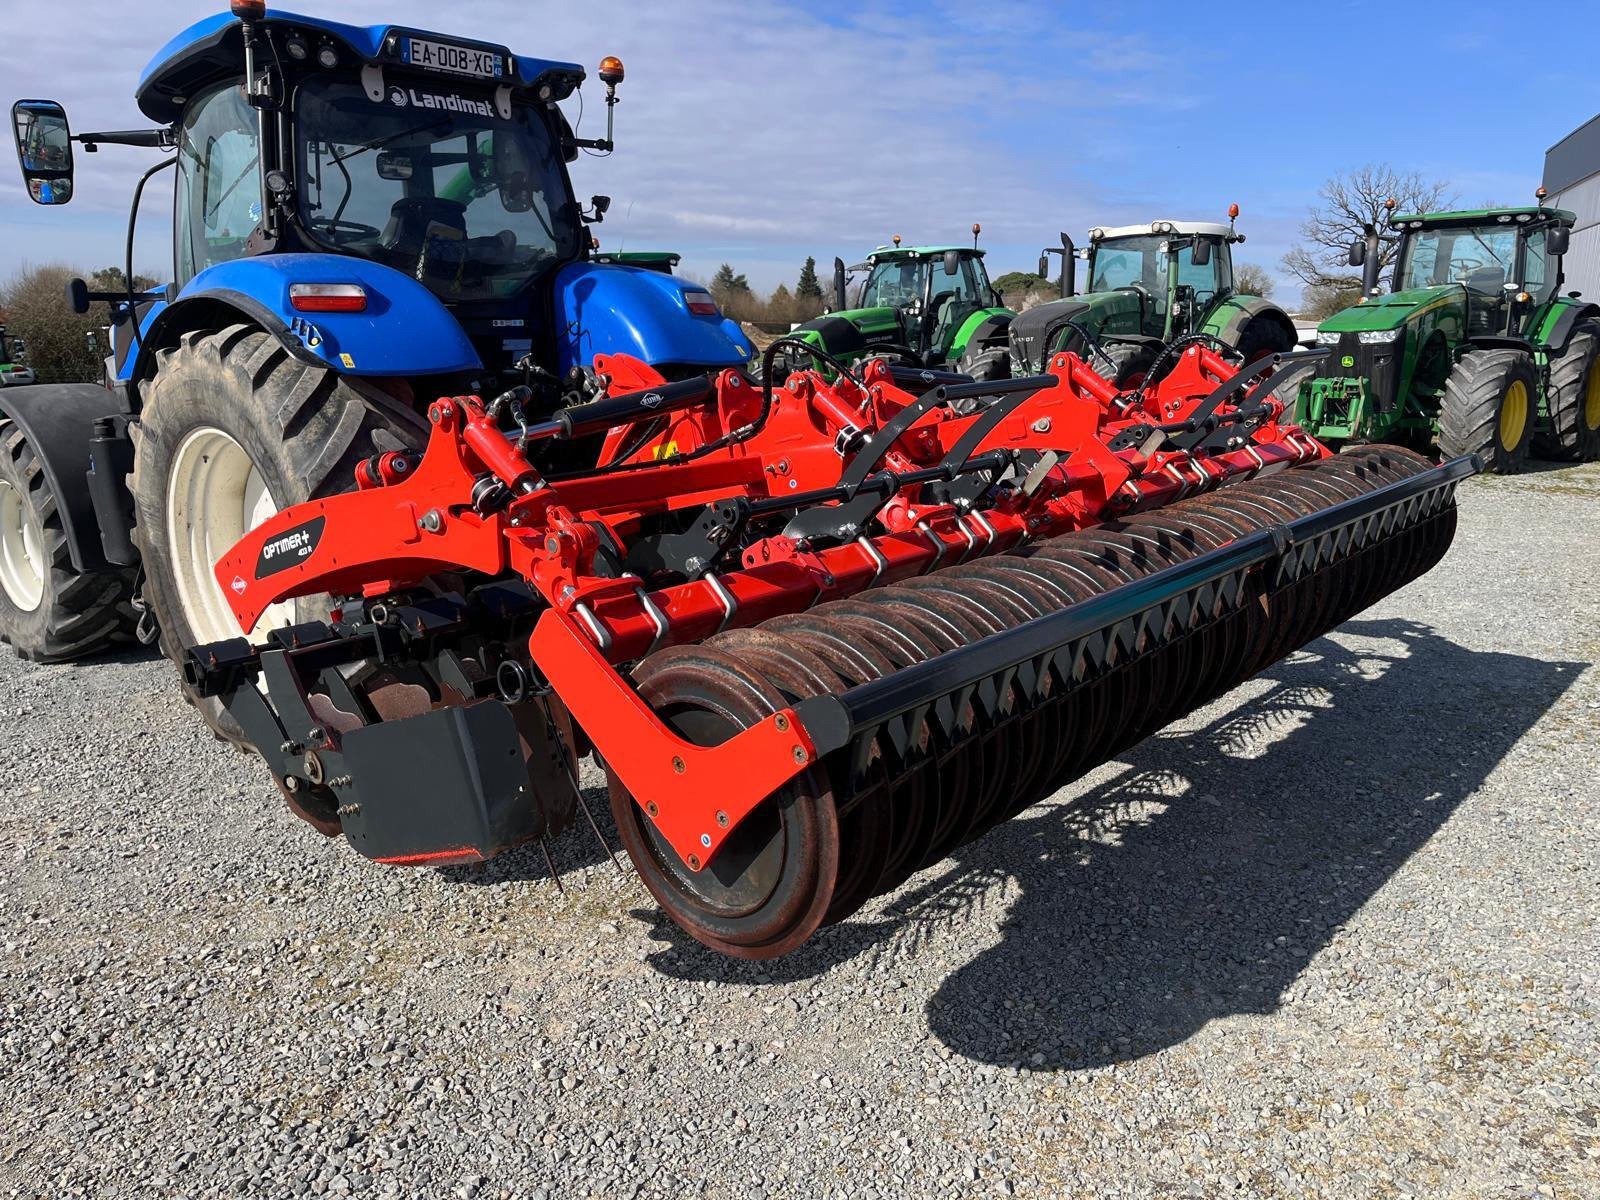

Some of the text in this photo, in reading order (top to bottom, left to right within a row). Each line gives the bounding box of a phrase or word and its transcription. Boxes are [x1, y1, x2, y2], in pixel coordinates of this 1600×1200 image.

[411, 41, 493, 75] EA-008-XG
[494, 66, 502, 75] 40
[409, 88, 494, 118] Landimat
[263, 530, 309, 559] OPTIMER+
[307, 545, 313, 553] R
